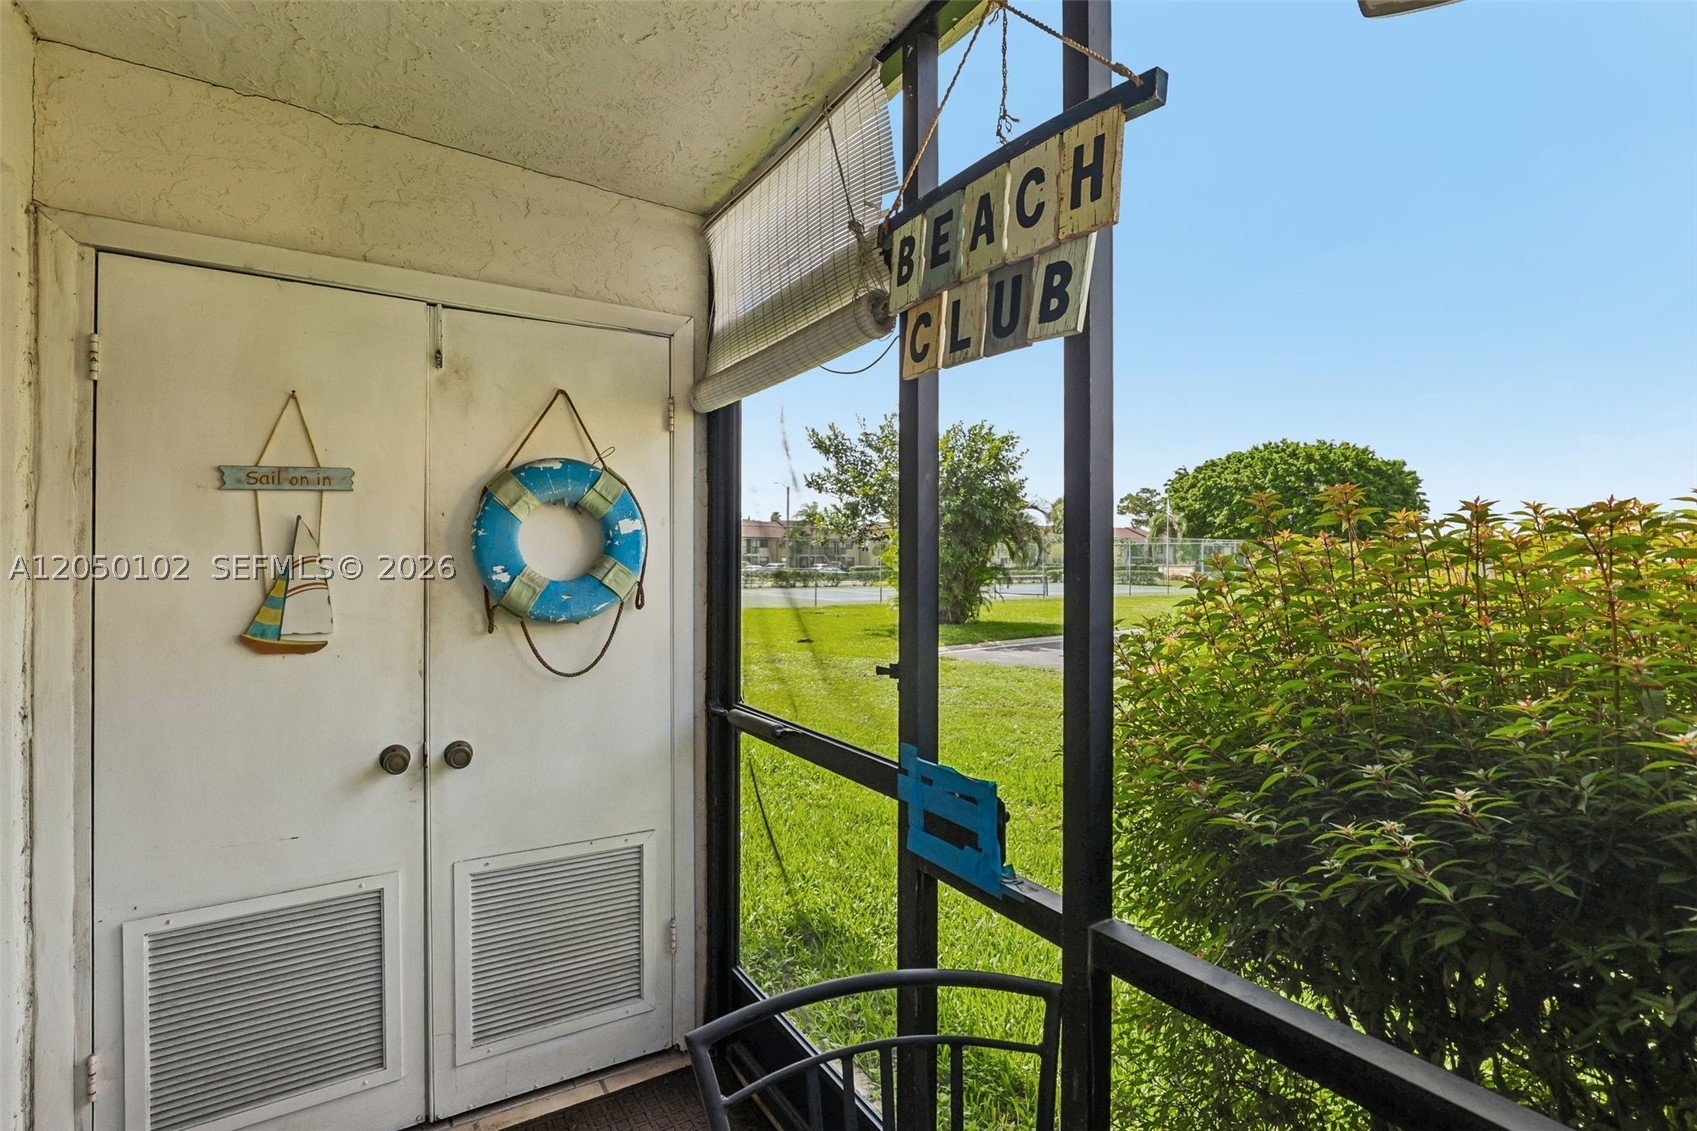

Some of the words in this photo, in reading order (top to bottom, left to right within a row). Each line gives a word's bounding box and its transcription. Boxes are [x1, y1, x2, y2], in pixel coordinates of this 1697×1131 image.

[896, 133, 1105, 287] BEACH
[909, 260, 1073, 363] CLUB
[245, 470, 280, 485] Sail
[289, 475, 309, 486] on
[317, 472, 331, 486] in
